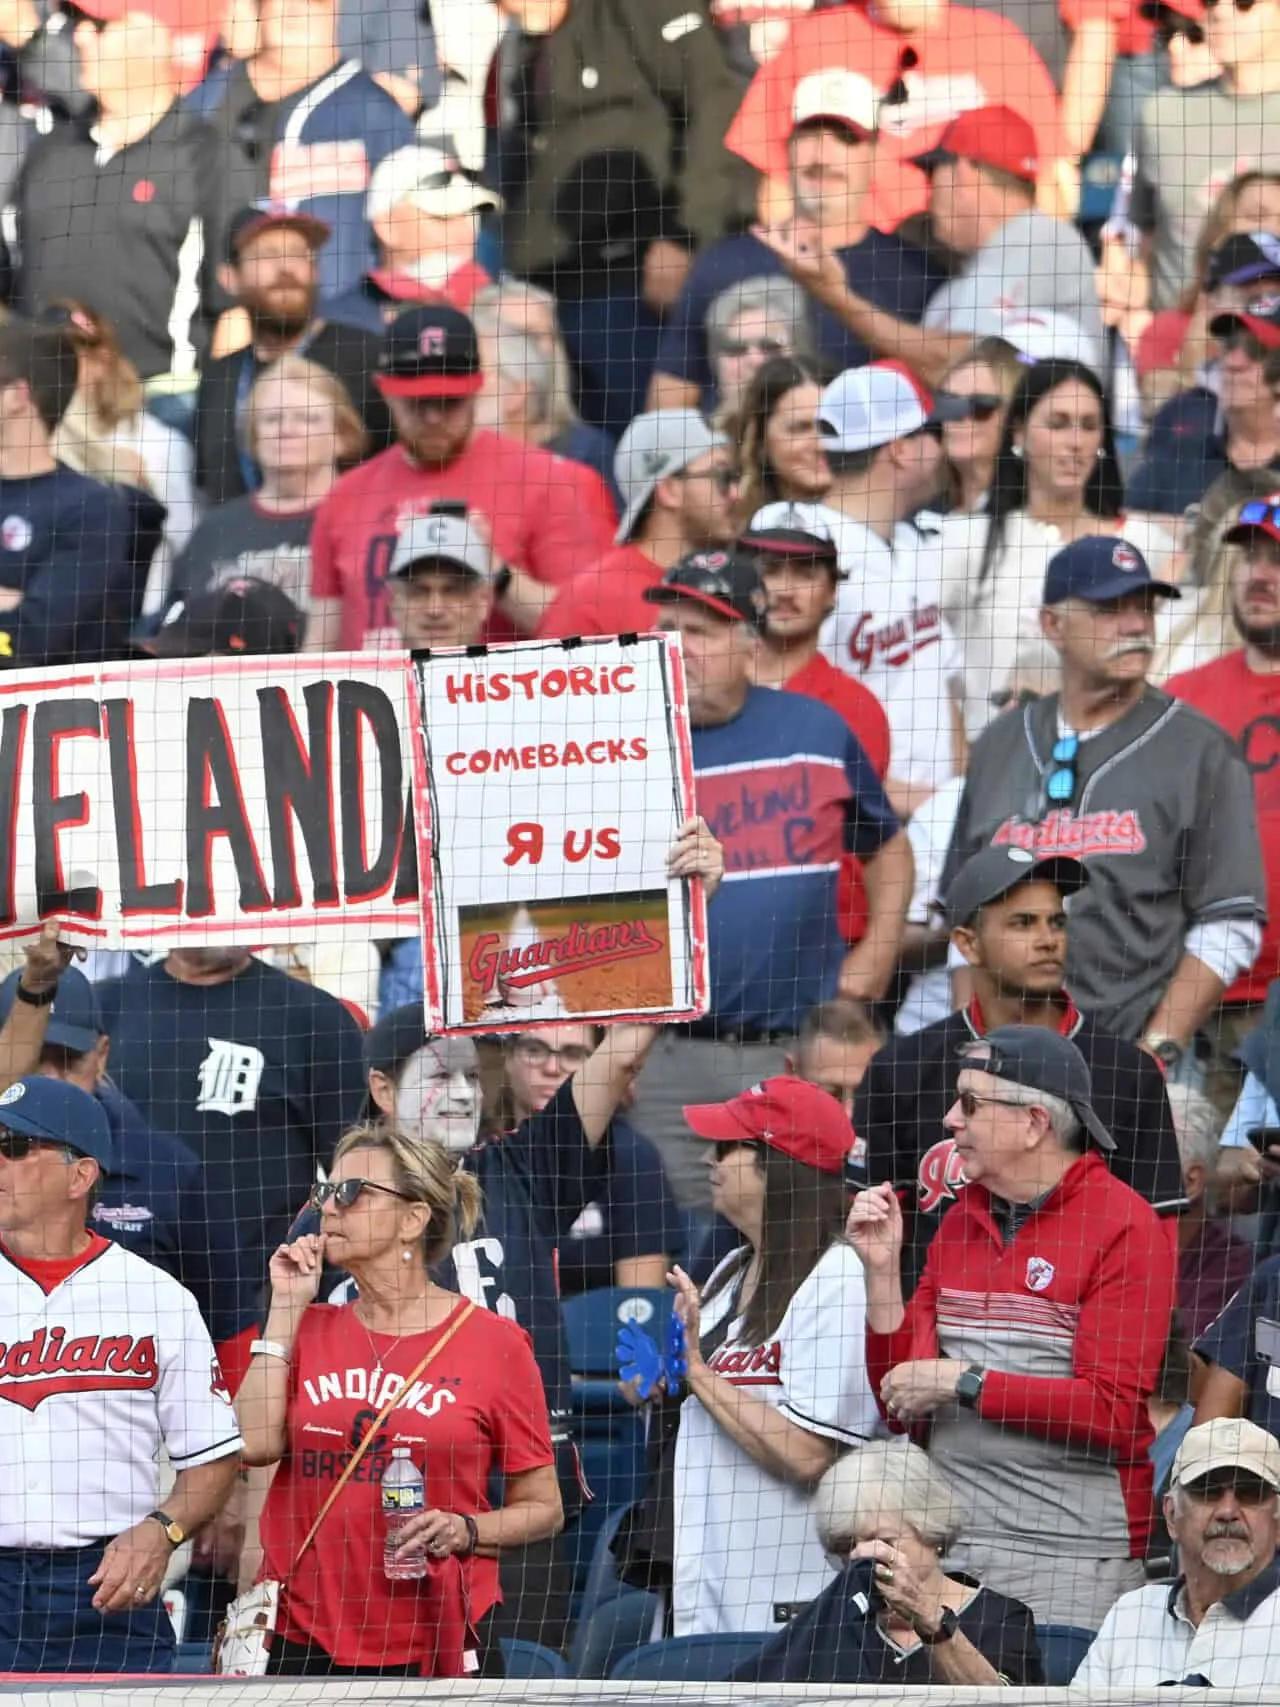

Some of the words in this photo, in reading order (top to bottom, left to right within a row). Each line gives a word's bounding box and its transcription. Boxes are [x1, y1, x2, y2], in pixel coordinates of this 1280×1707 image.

[446, 737, 648, 775] COMEBACKS
[563, 827, 621, 864] US
[471, 918, 664, 995] Guardians
[196, 1036, 265, 1116] D
[303, 1367, 457, 1418] INDIANS
[302, 1450, 392, 1484] BASEB
